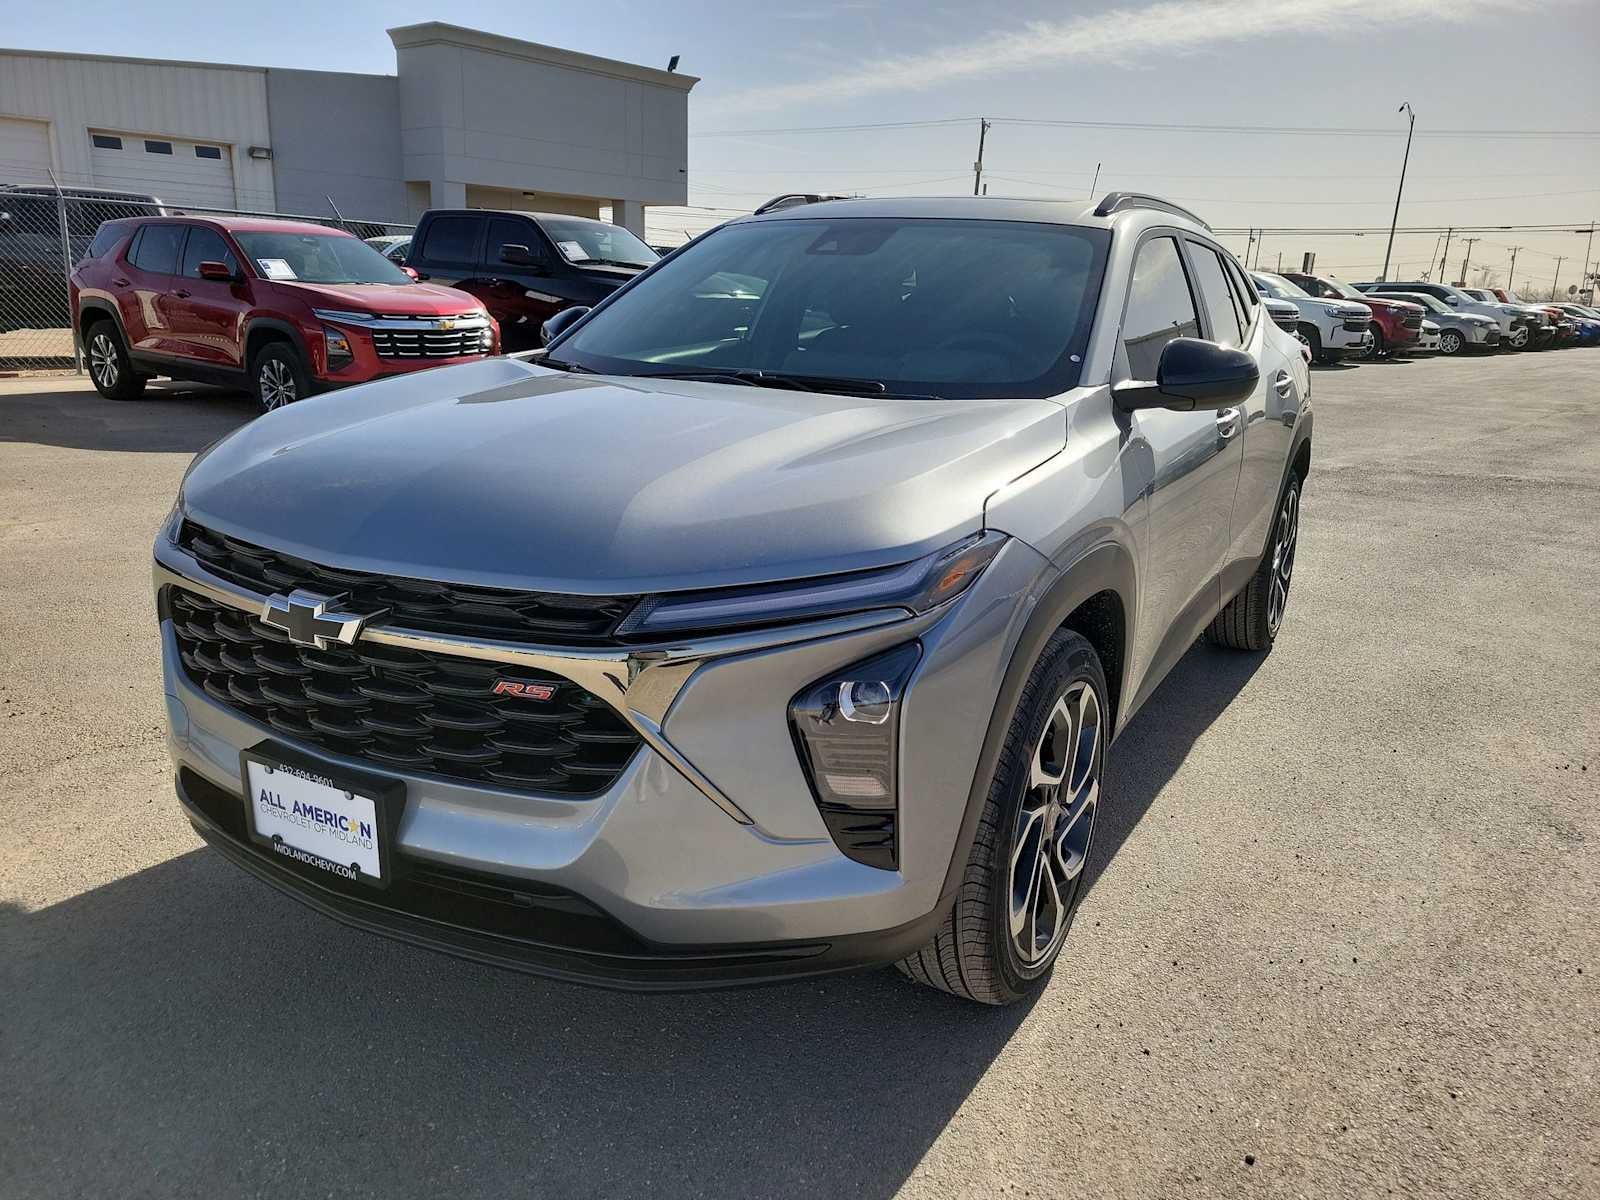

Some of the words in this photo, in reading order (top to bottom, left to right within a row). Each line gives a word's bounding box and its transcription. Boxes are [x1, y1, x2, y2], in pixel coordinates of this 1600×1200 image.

[493, 681, 555, 701] RS
[259, 788, 286, 810] ALL
[260, 803, 311, 830] CHEVROLET
[313, 822, 327, 834] OF
[329, 828, 373, 850] MIDLAND
[274, 842, 357, 880] MIDLANDCHEVY.COM
